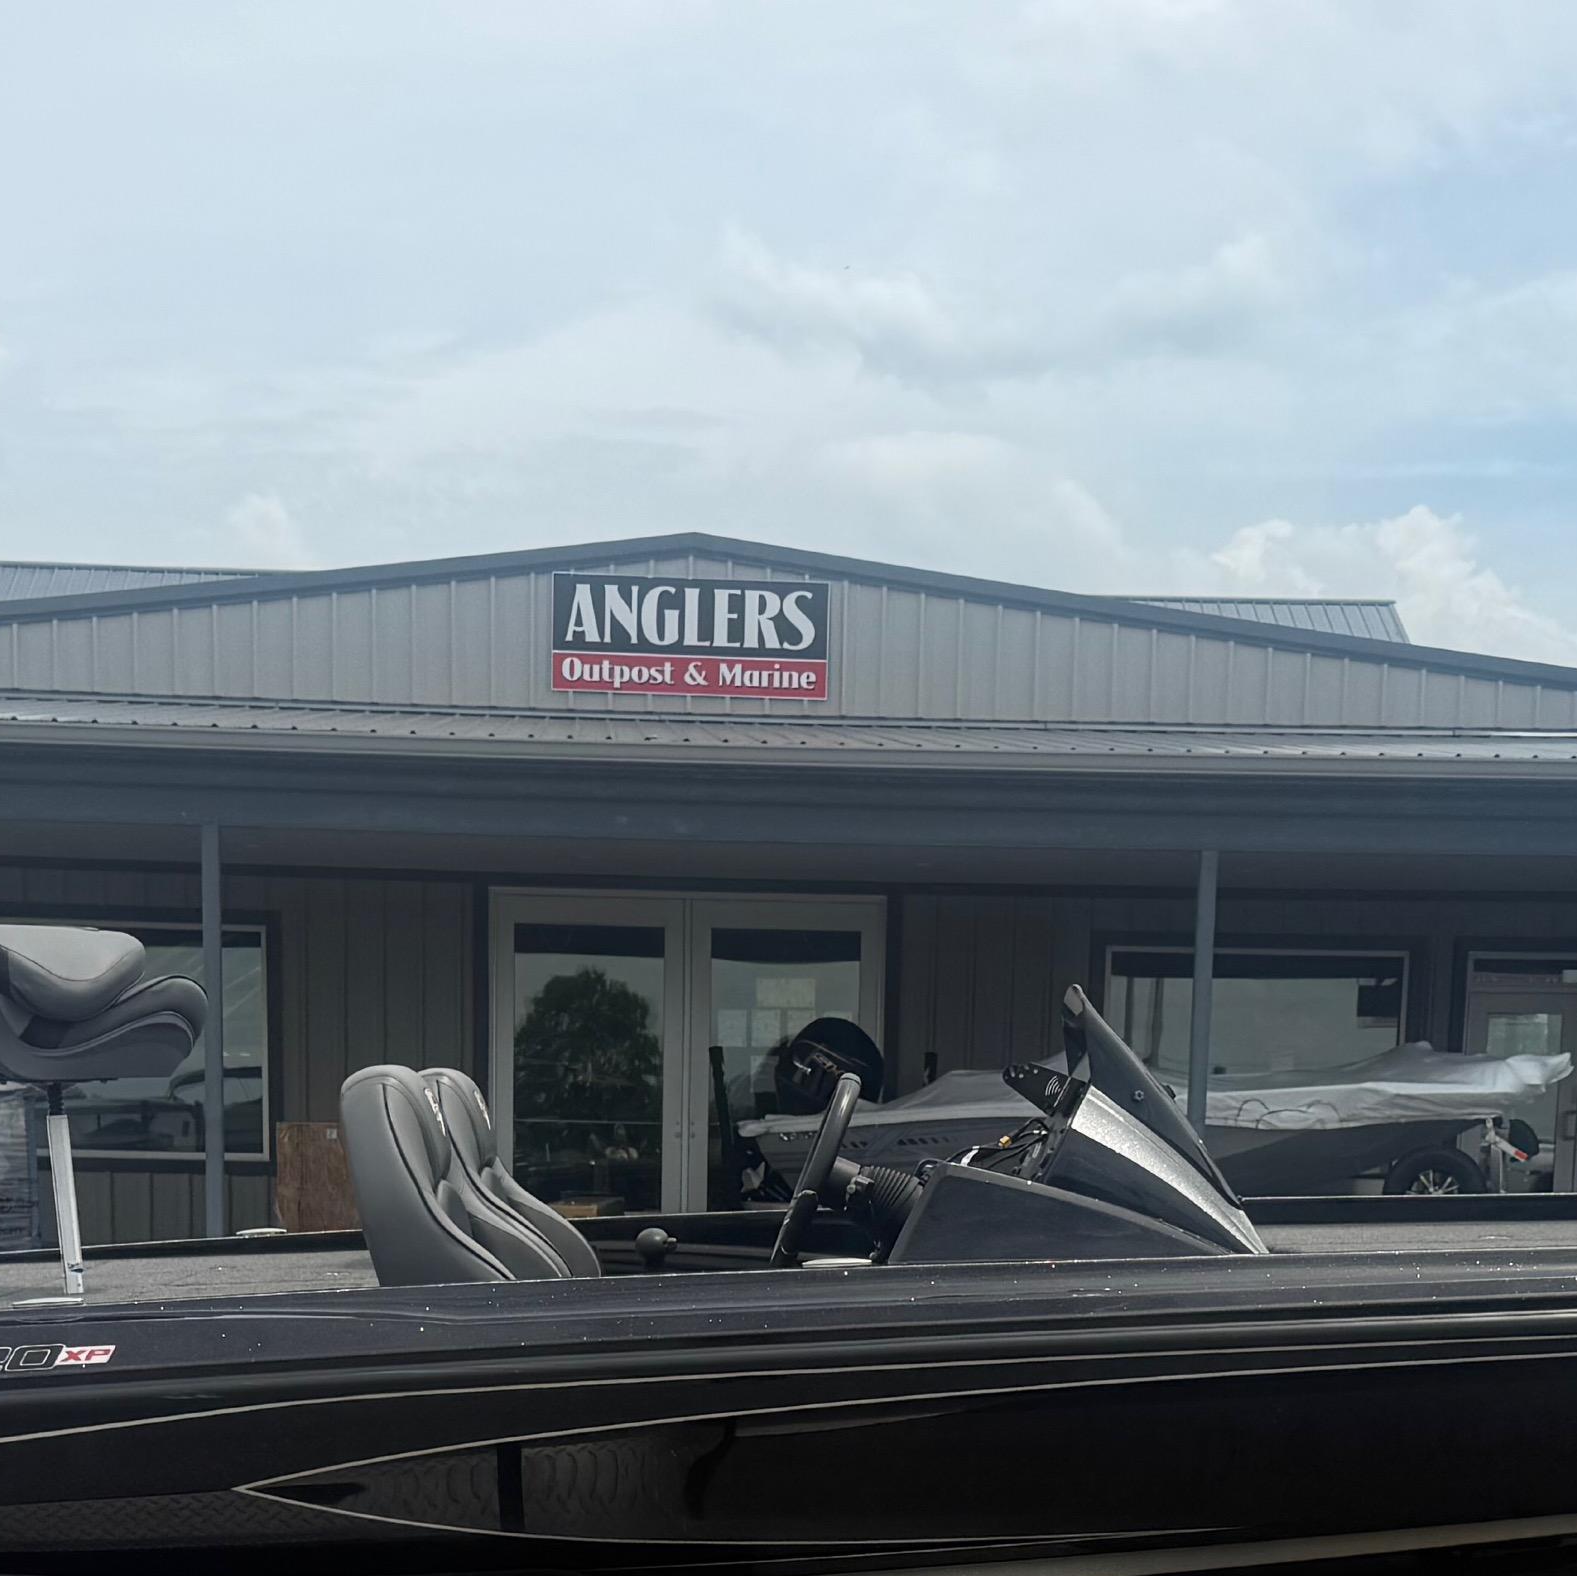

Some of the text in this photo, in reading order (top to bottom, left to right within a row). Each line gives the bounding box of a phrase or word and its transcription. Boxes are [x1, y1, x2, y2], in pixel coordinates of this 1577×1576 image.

[564, 582, 817, 651] ANGLERS
[561, 656, 818, 690] Outpost & Marine
